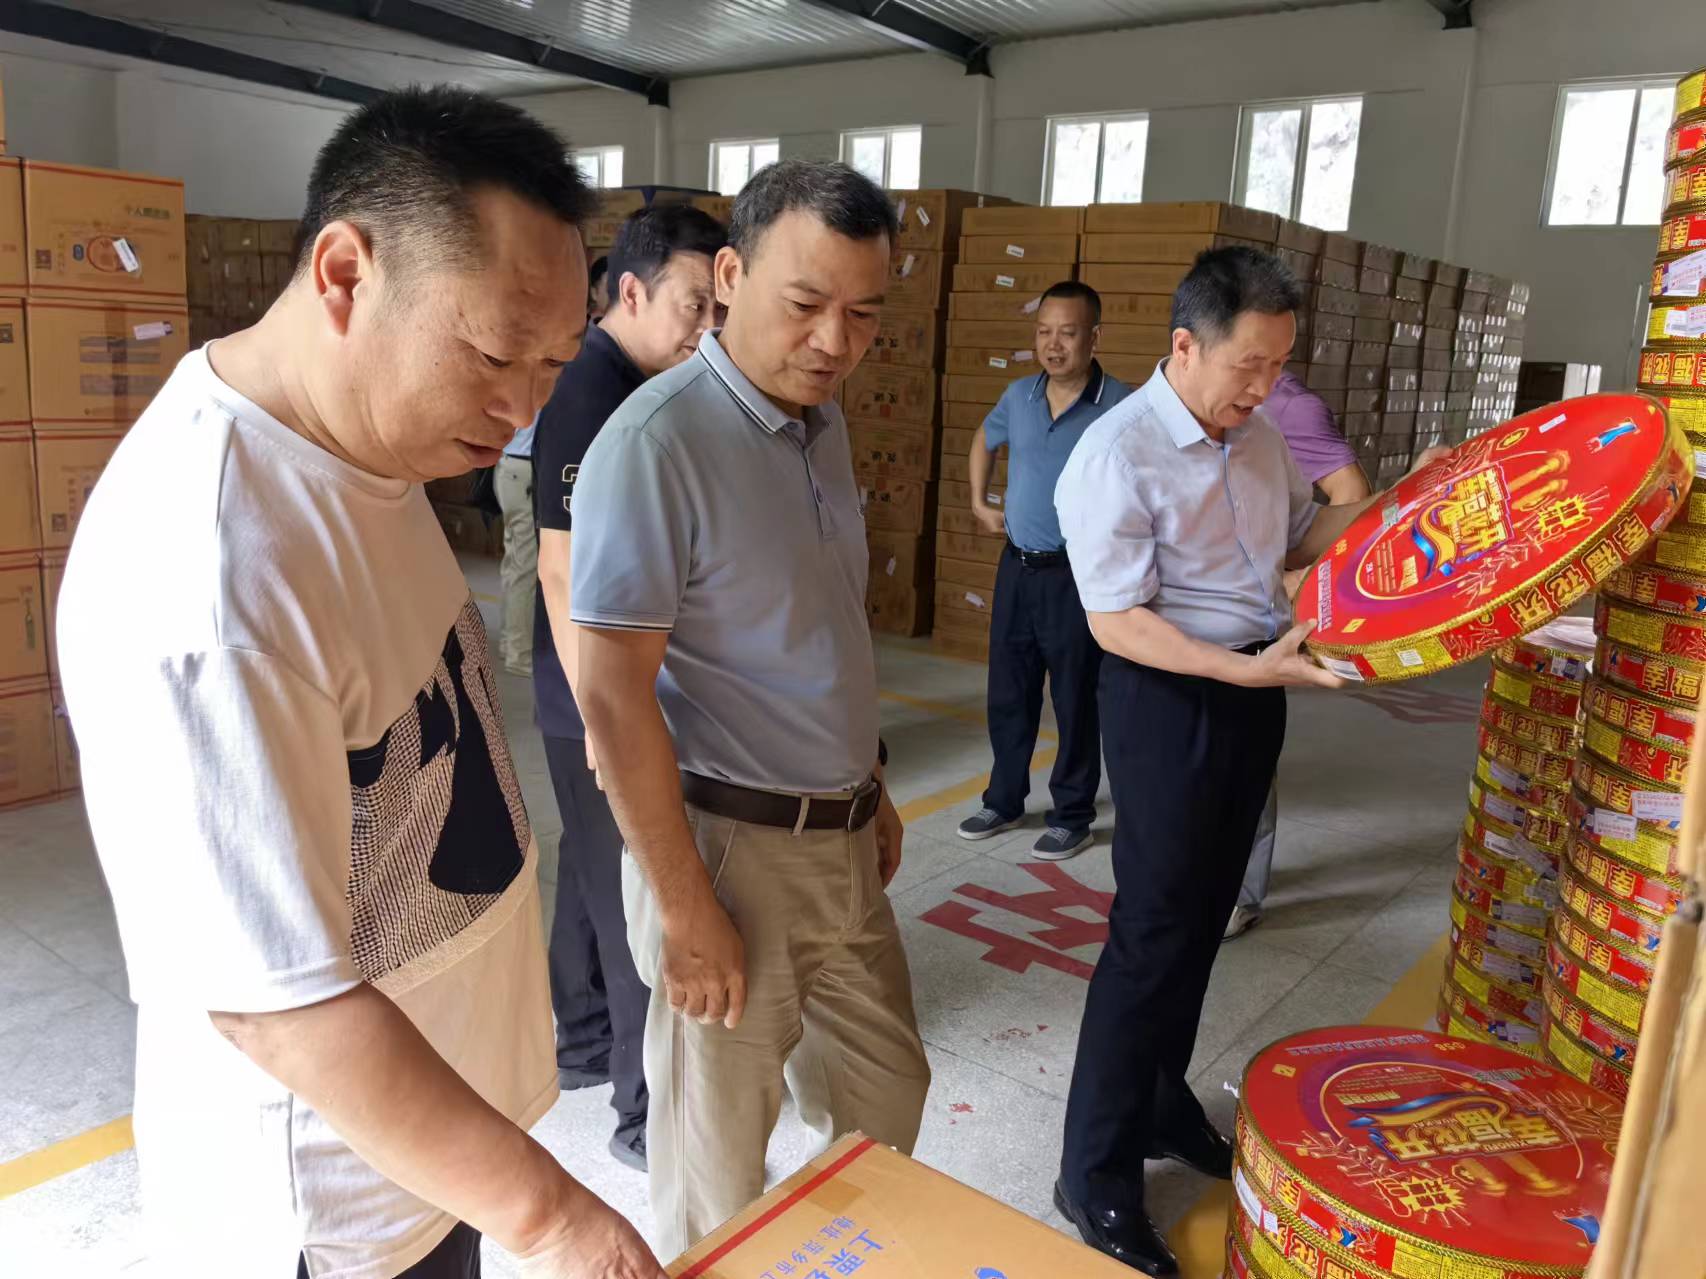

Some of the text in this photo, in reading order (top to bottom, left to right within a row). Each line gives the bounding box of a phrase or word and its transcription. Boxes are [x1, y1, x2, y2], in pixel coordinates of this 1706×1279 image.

[1510, 514, 1650, 628] 幸福花开
[1384, 1108, 1561, 1160] 幸福花开
